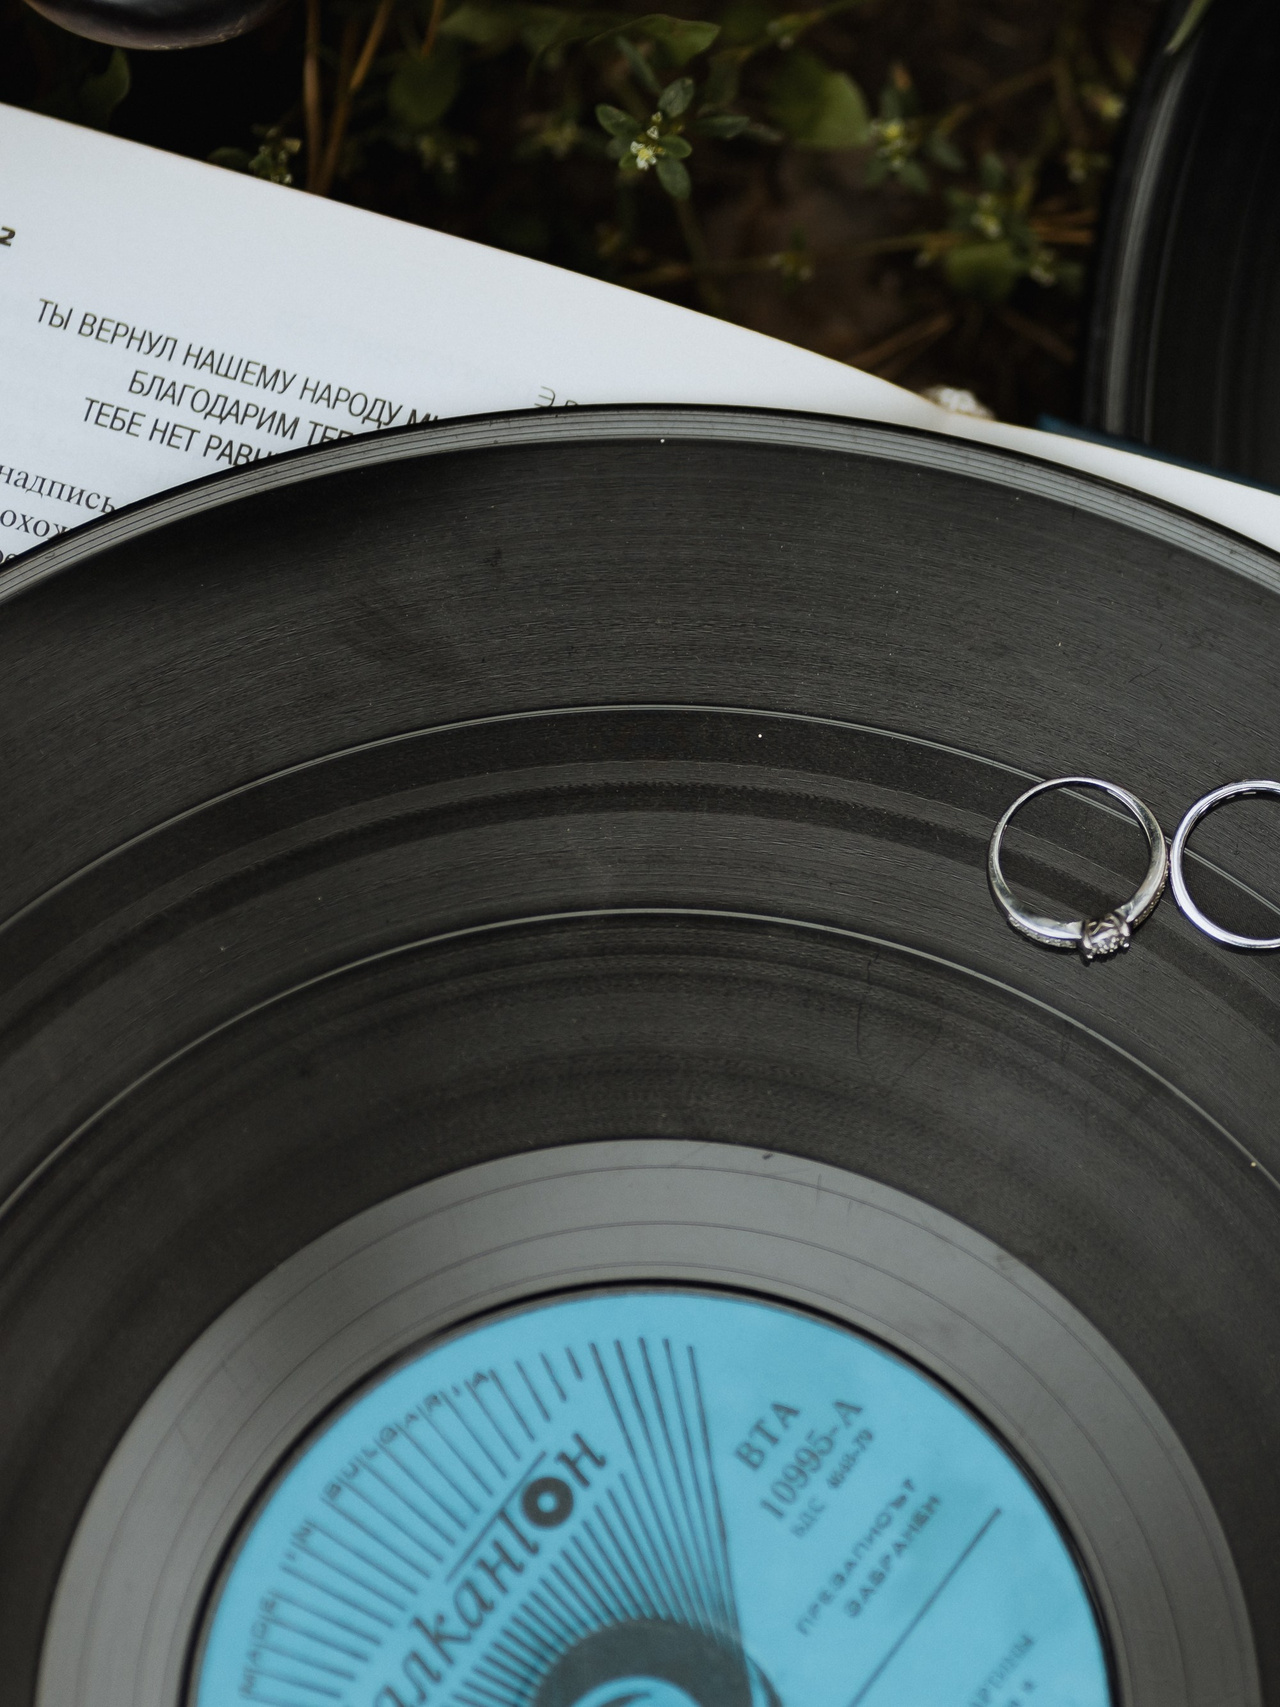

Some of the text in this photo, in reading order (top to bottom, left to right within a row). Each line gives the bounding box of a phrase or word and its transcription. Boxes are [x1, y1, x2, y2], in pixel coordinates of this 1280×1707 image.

[37, 297, 404, 430] ТЫ ВЕРНУЛ НАШЕМУ НАРОДУ
[83, 396, 147, 438] ТЕБЕ
[148, 417, 201, 452] НЕТ
[127, 369, 301, 441] БЛАГОДАРИМ
[0, 463, 117, 515] надпись
